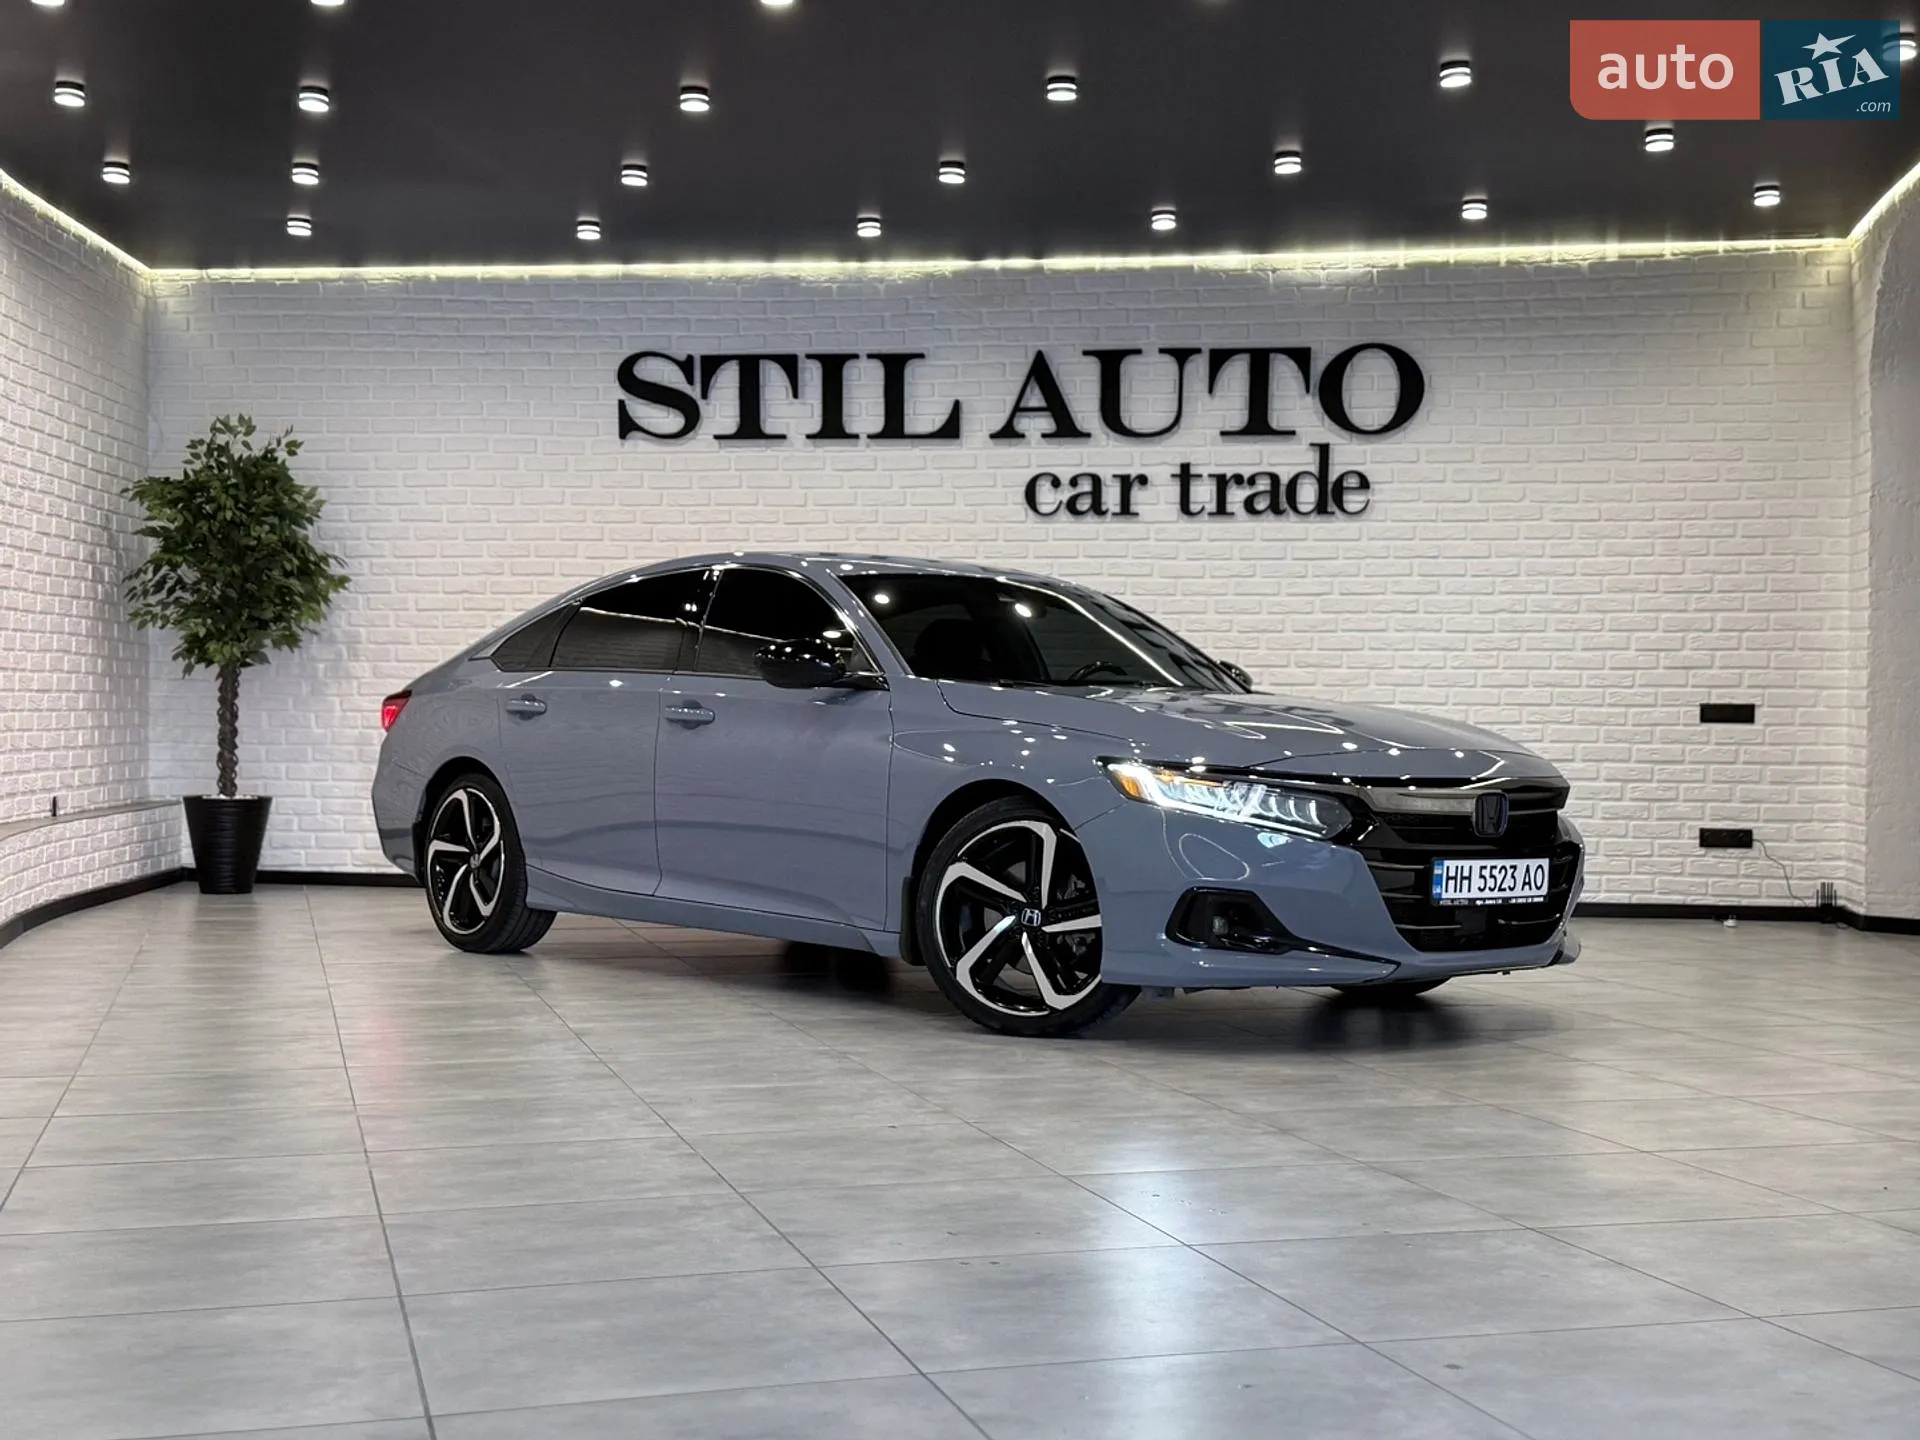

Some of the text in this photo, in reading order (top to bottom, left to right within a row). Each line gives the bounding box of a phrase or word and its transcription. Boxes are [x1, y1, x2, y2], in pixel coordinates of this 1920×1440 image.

[617, 342, 1426, 440] STIL AUTO
[1025, 443, 1370, 518] car trade
[1445, 865, 1473, 893] HH
[1477, 864, 1518, 893] 5523
[1521, 864, 1545, 892] AO
